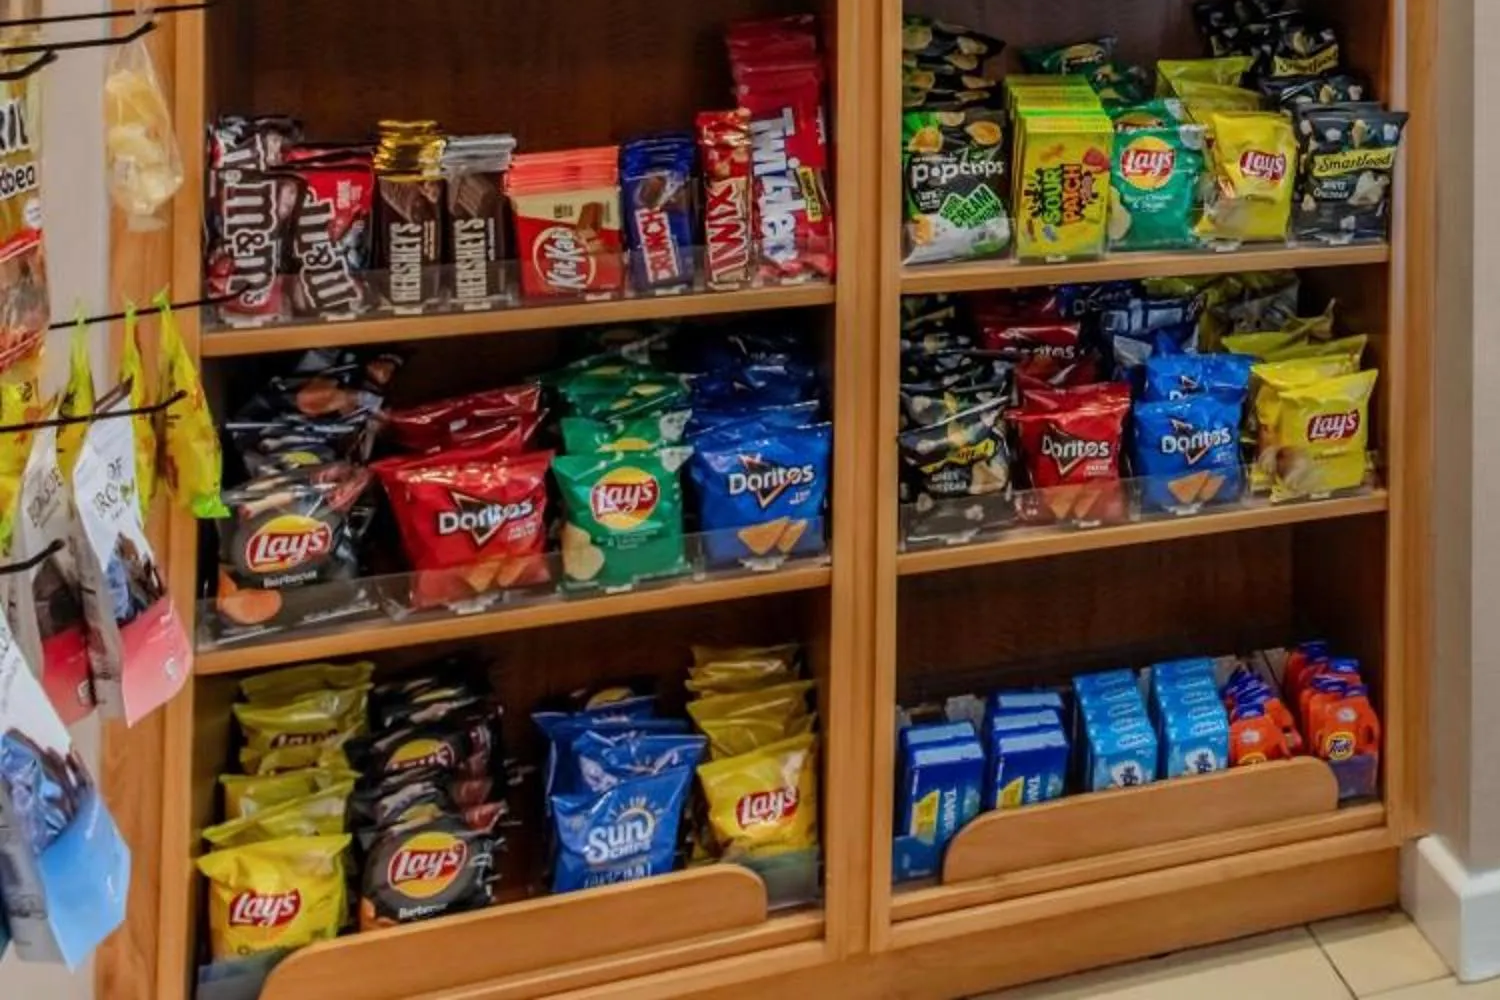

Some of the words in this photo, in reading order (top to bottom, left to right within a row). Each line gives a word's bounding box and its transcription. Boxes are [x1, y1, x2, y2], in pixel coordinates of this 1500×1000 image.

[1123, 149, 1175, 178] Lay's
[1241, 150, 1287, 181] Lay's
[1316, 151, 1393, 173] Smartfood
[1043, 167, 1062, 225] SOUR
[1061, 163, 1083, 225] PATCH
[634, 208, 679, 283] CRUNCH
[707, 178, 748, 290] TWIX
[1161, 427, 1231, 454] Doritos
[1308, 410, 1359, 441] Lay's
[1041, 435, 1111, 458] Doritos
[592, 478, 658, 514] Lay's
[728, 464, 815, 495] Doritos
[438, 500, 534, 535] Doritos
[250, 524, 331, 566] Lay's
[740, 787, 797, 826] Lay's
[586, 818, 654, 866] Sun
[391, 844, 466, 882] Lay's
[230, 891, 300, 926] Lay's
